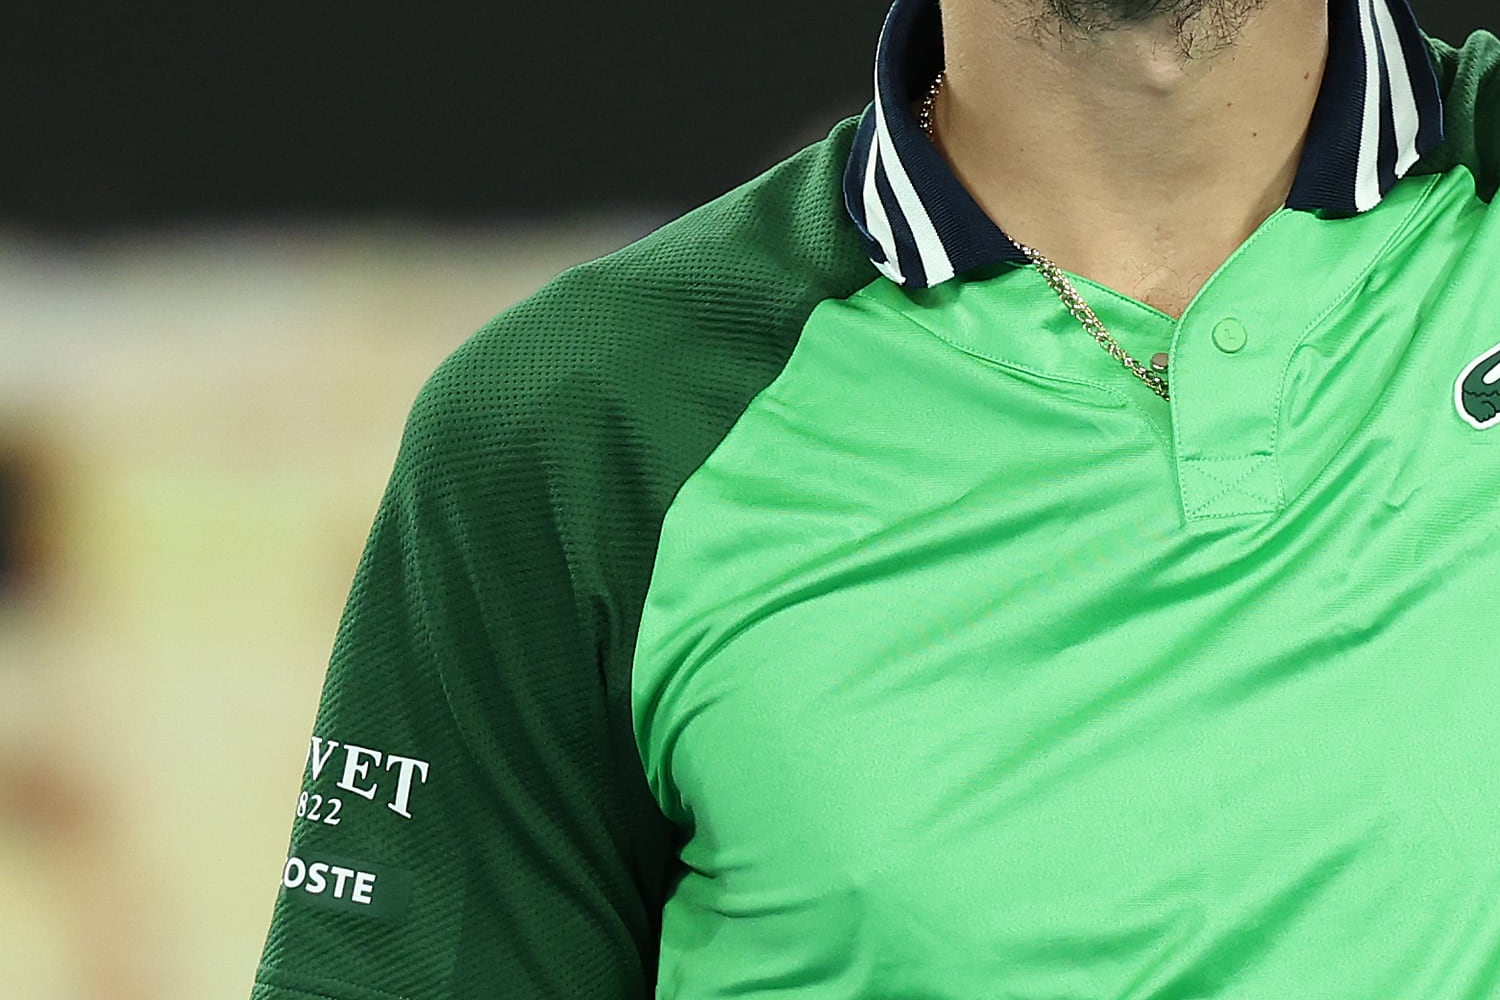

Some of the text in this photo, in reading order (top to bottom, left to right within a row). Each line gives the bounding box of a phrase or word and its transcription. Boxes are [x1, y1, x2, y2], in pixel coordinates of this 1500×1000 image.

[310, 736, 429, 819] VET
[297, 791, 342, 825] 822
[282, 857, 376, 904] OSTE
